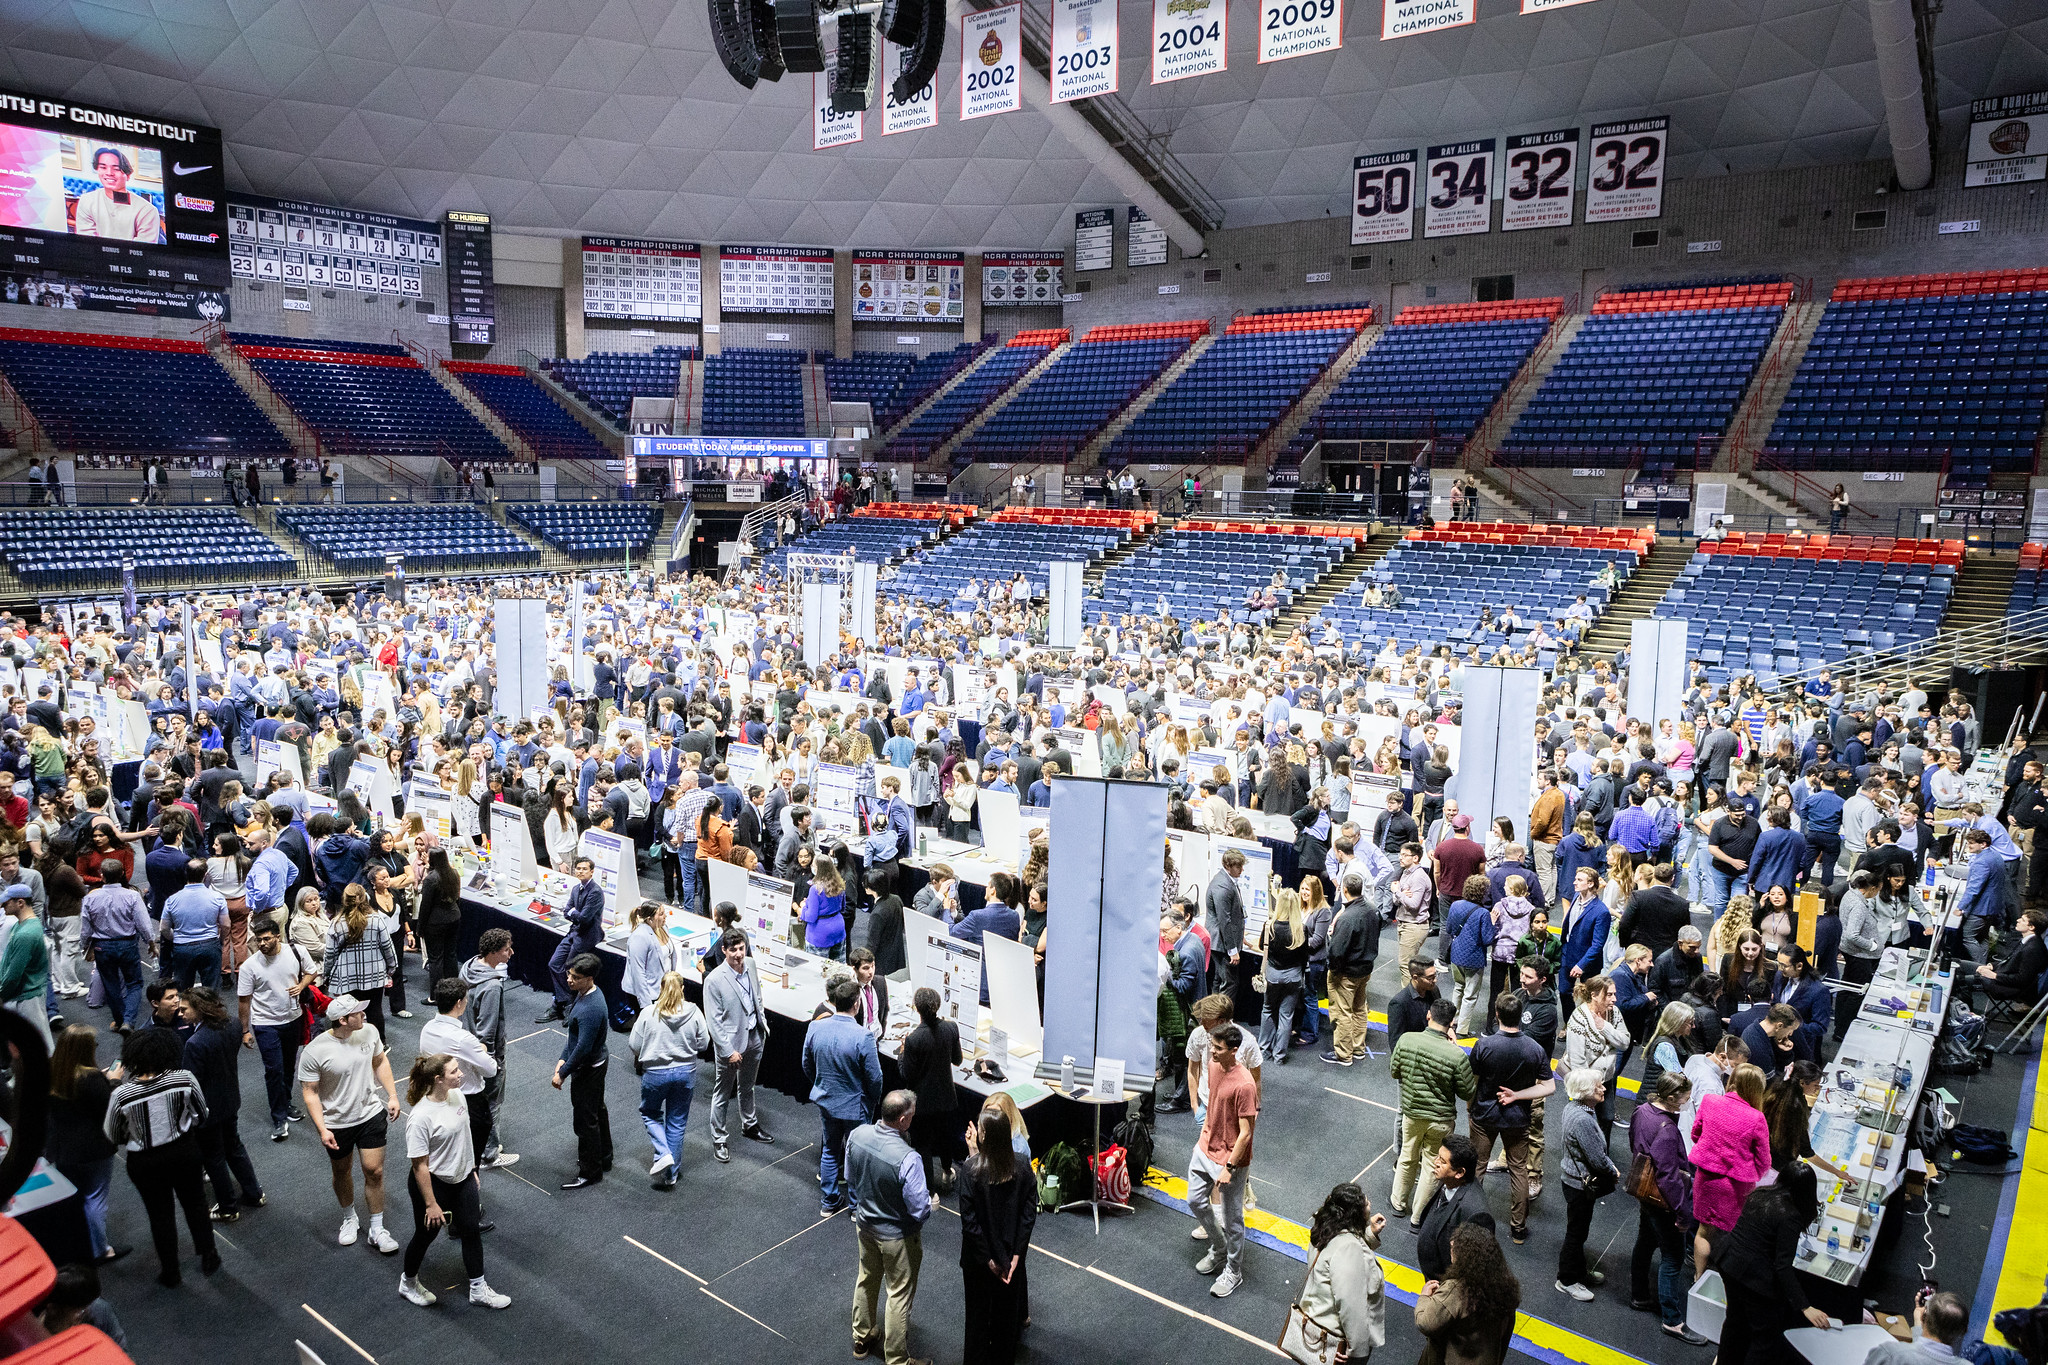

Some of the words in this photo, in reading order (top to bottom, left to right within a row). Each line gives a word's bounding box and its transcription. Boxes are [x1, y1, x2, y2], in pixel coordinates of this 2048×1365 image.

[967, 13, 988, 23] UConn
[989, 6, 1016, 17] Women's
[1267, 0, 1335, 30] 2009
[1398, 0, 1458, 18] NATIONAL
[976, 17, 1007, 30] Basketball
[1392, 12, 1463, 33] CHAMPIONS
[1159, 20, 1220, 52] 2004
[1273, 25, 1327, 43] NATIONAL
[1268, 37, 1331, 57] CHAMPIONS
[1057, 46, 1111, 75] 2003
[1164, 48, 1213, 65] NATIONAL
[1160, 60, 1217, 78] CHAMPIONS
[967, 64, 1015, 92] 2002
[1062, 71, 1106, 86] NATIONAL
[971, 89, 1010, 103] NATIONAL
[1059, 82, 1110, 99] CHAMPIONS
[892, 106, 927, 119] NATIONAL
[968, 100, 1013, 114] CHAMPIONS
[1973, 99, 1998, 113] GENO
[1975, 111, 2005, 120] CLASS
[40, 102, 65, 118] OF
[70, 108, 196, 143] CONNECTICUT
[822, 122, 854, 134] NATIONAL
[888, 117, 930, 130] CHAMPIONS
[1594, 124, 1626, 136] RICHARD
[1628, 120, 1665, 132] HAMILTON
[819, 132, 857, 145] CHAMPIONS
[1520, 135, 1541, 146] SWIN
[1543, 132, 1564, 143] CASH
[1441, 147, 1455, 156] RAY
[1456, 143, 1480, 154] ALLEN
[1360, 155, 1390, 167] REBECCA
[1392, 152, 1410, 162] LOBO
[1593, 136, 1660, 191] 32
[1509, 148, 1571, 201] 32
[1430, 157, 1486, 209] 34
[1357, 168, 1411, 217] 50
[187, 197, 214, 206] DUNKIN'
[187, 203, 214, 212] DONUTS
[278, 201, 308, 210] UCONN
[313, 207, 351, 218] HUSKIES
[370, 216, 398, 225] HONOR
[1506, 215, 1536, 223] NUMBER
[1538, 213, 1568, 221] RETIRED
[236, 221, 247, 235] 32
[269, 225, 274, 238] 3
[1962, 222, 1979, 230] 211
[175, 232, 211, 242] TRAVELERS
[322, 232, 333, 246] 20
[1354, 230, 1380, 238] NUMBER
[349, 237, 359, 250] 31
[375, 240, 385, 253] 23
[620, 240, 694, 250] CHAMPIONSHIP
[399, 244, 410, 257] 31
[424, 247, 435, 260] 14
[756, 248, 827, 256] CHAMPIONSHIP
[14, 254, 26, 262] TM
[27, 256, 39, 264] FLS
[233, 258, 252, 271] 23
[120, 265, 132, 274] FLS
[184, 273, 199, 281] FULL
[264, 263, 273, 273] 4
[286, 265, 302, 276] 30
[315, 268, 323, 279] 3
[334, 271, 351, 282] CD
[360, 274, 372, 285] 15
[381, 276, 397, 288] 24
[404, 279, 419, 291] 33
[80, 284, 100, 293] Harry
[109, 286, 134, 297] Gampel
[135, 288, 161, 297] Pavilion
[165, 291, 185, 300] Storrs,
[90, 292, 124, 302] Basketball
[125, 296, 148, 306] Capital
[167, 299, 187, 307] World
[470, 331, 489, 342] 1:42
[815, 443, 823, 453] E
